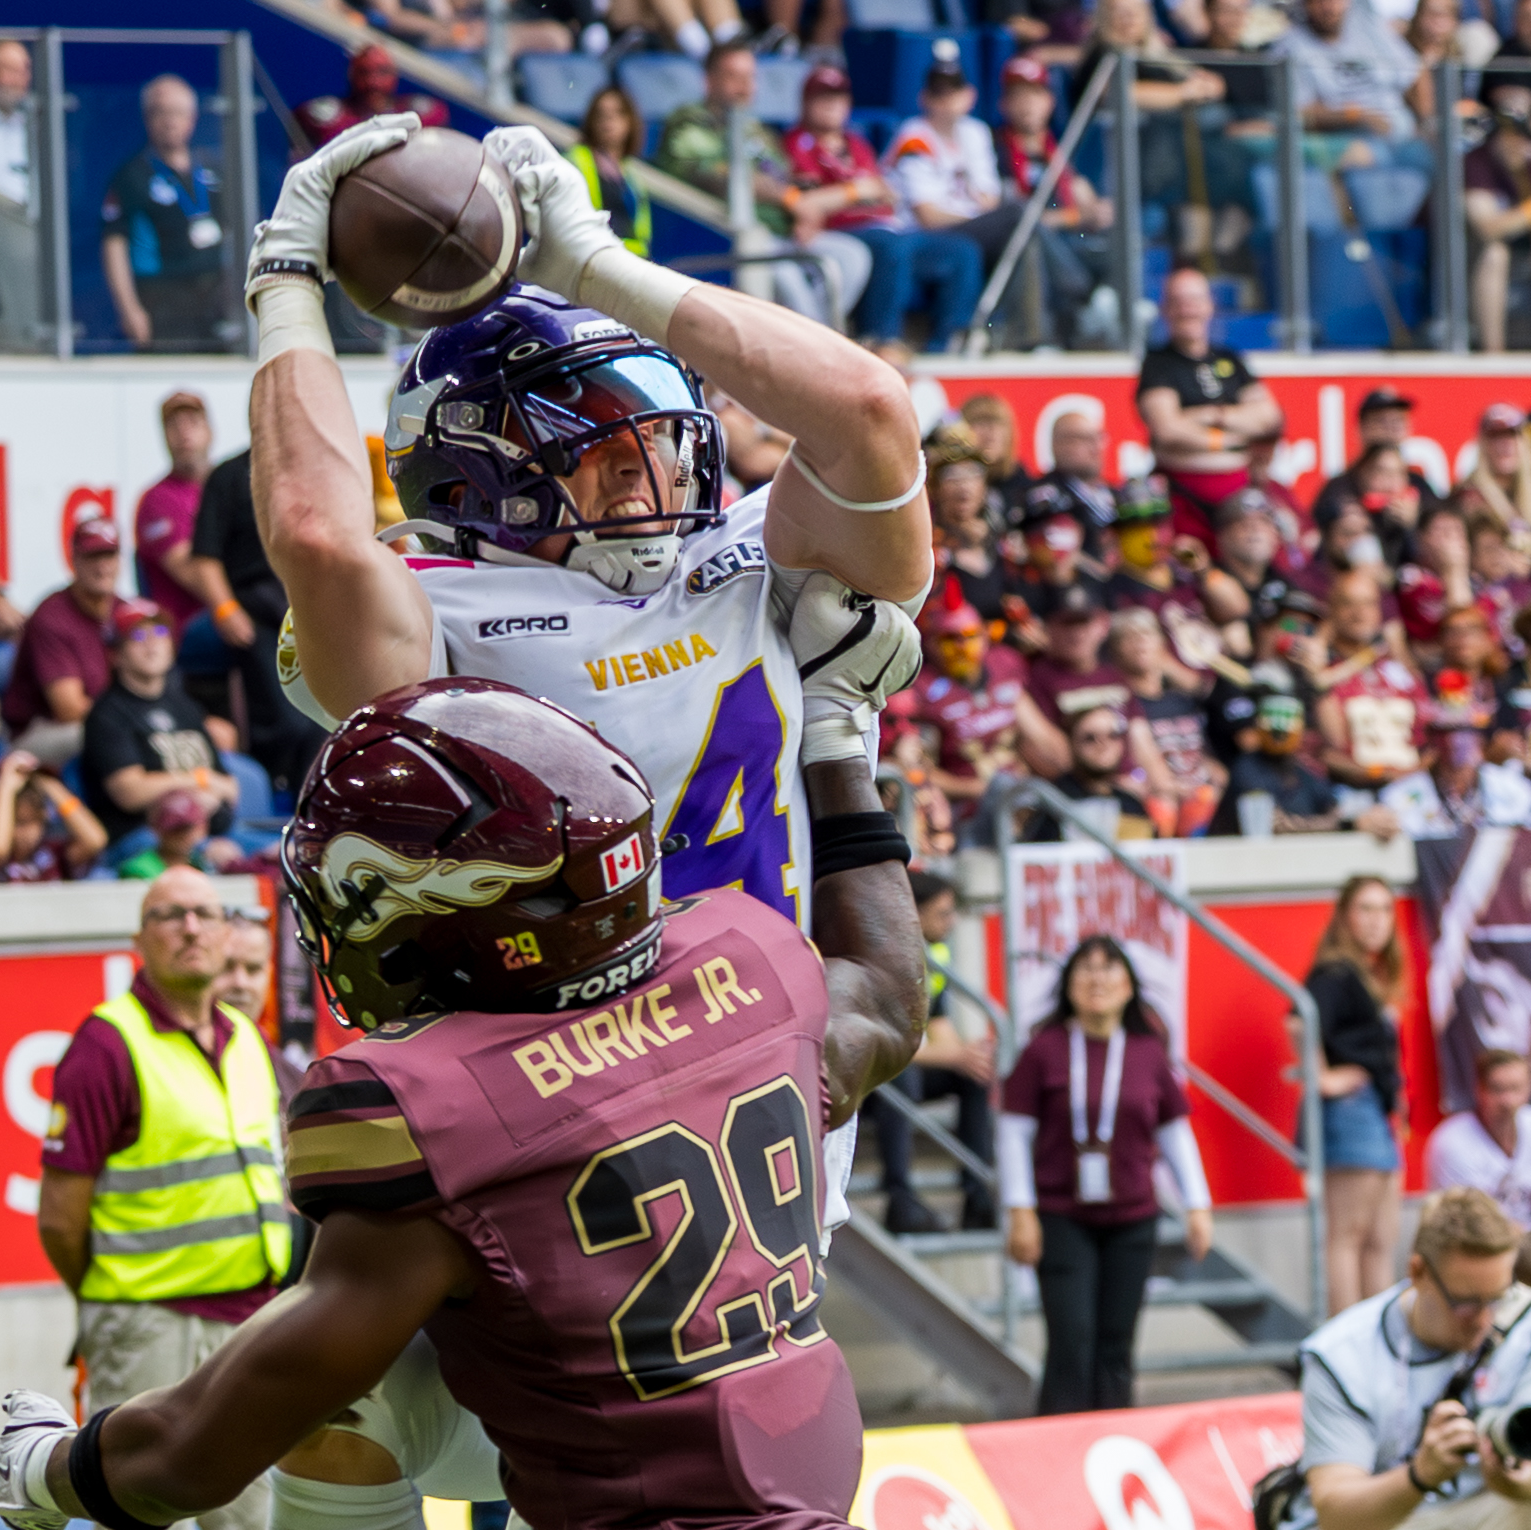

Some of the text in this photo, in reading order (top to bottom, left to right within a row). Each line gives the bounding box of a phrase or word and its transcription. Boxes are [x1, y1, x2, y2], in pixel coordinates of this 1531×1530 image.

[674, 446, 695, 489] Riddell
[631, 546, 665, 557] Riddell
[700, 541, 766, 590] AFLE
[583, 632, 719, 692] VIENNA
[495, 931, 543, 972] 29
[511, 955, 764, 1099] BURKE JR.
[566, 1073, 829, 1401] 29
